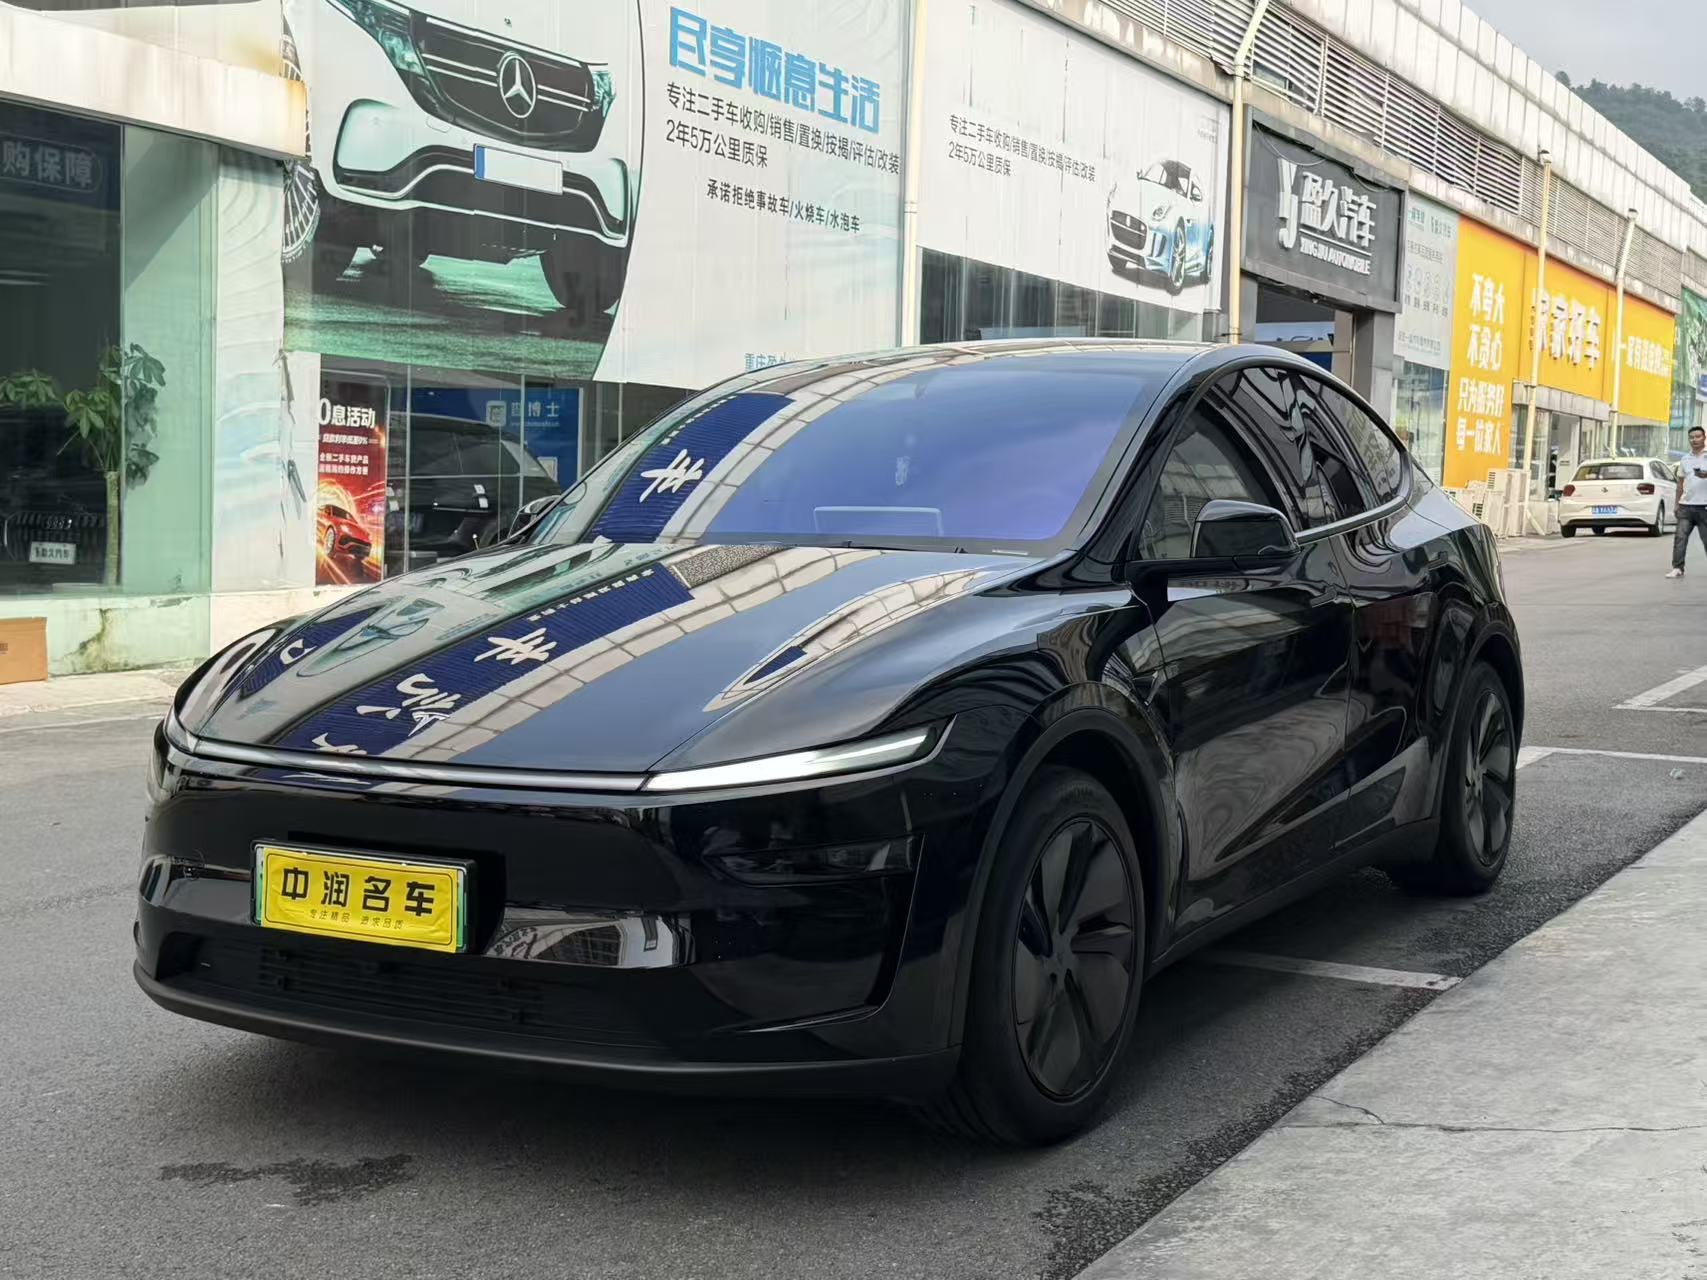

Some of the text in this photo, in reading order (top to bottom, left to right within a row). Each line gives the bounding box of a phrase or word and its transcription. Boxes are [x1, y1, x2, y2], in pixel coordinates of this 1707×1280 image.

[2, 140, 93, 188] 购保障
[666, 119, 768, 168] 2年5万公里质保
[1301, 172, 1377, 247] 盈久汽车
[281, 867, 436, 917] 中润名车
